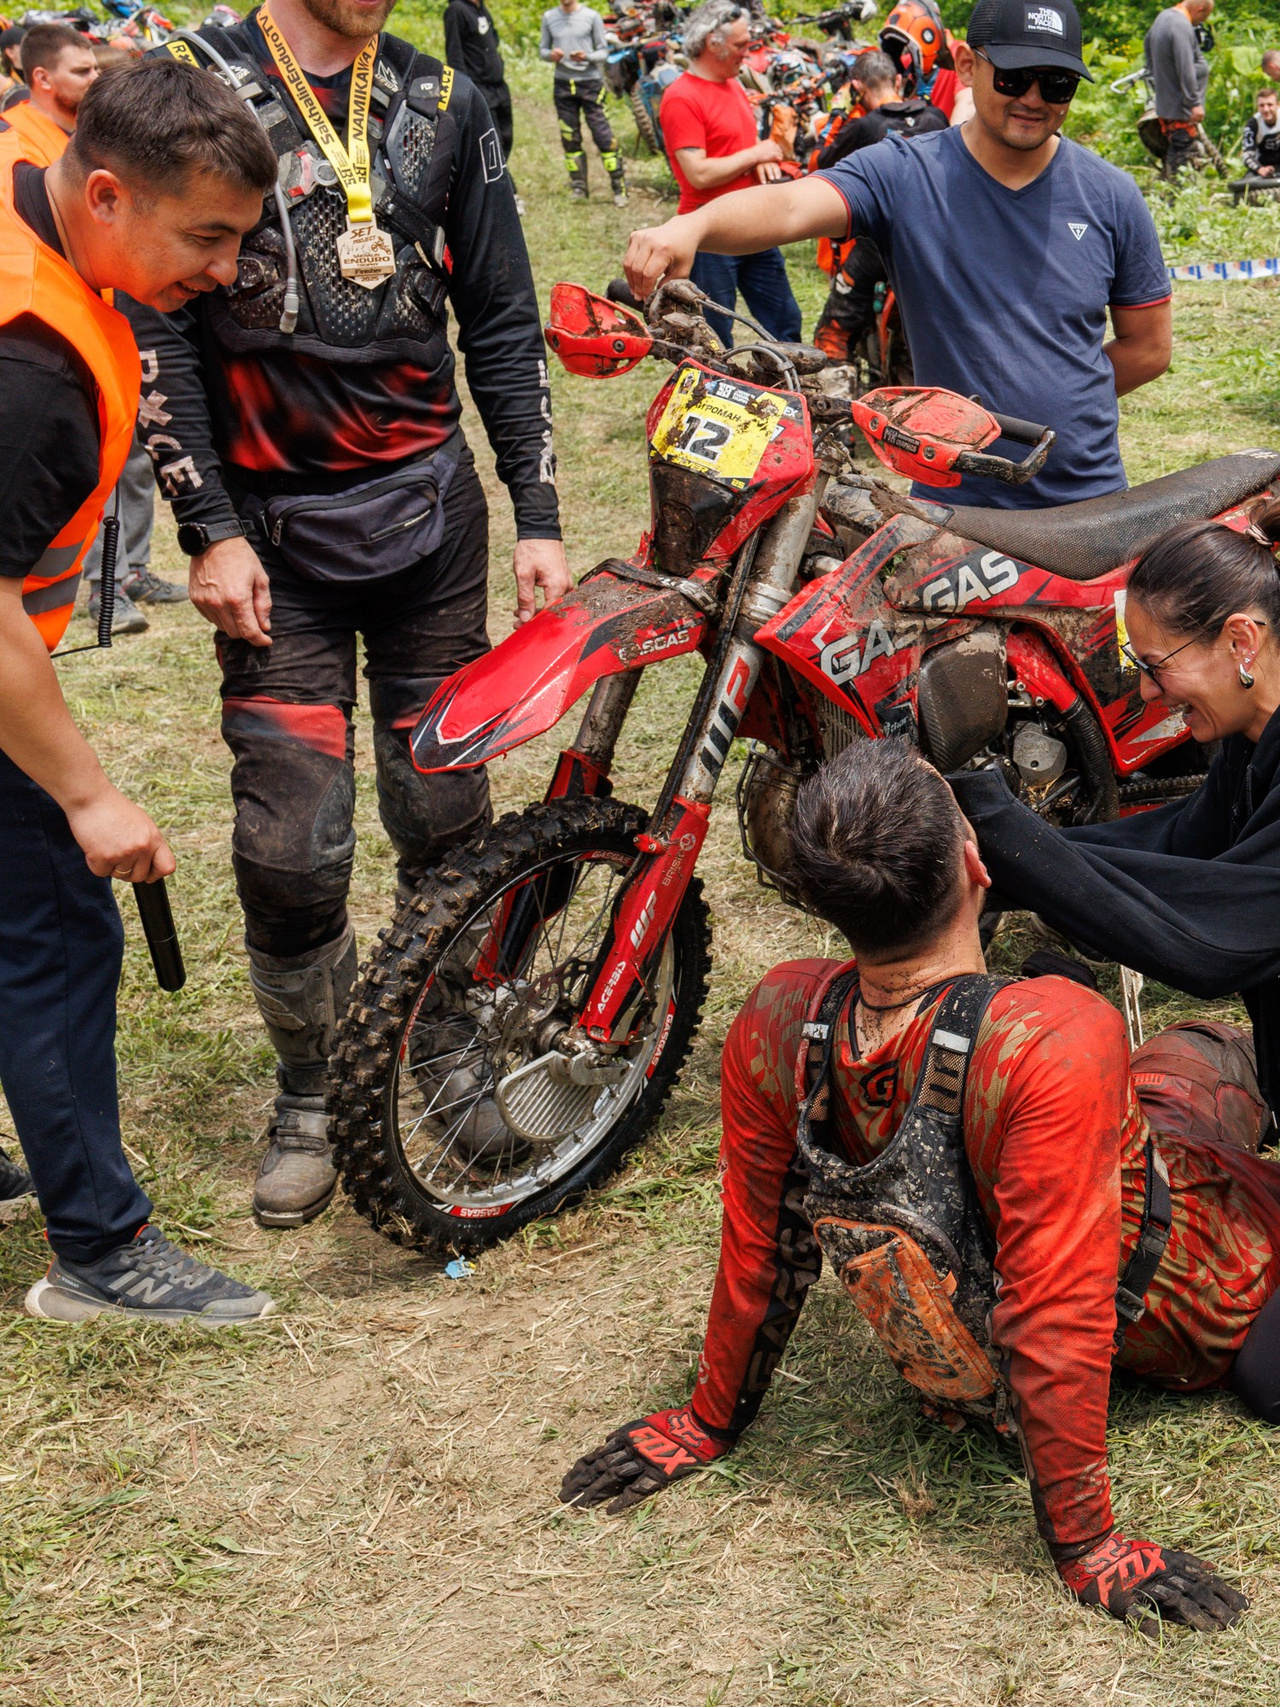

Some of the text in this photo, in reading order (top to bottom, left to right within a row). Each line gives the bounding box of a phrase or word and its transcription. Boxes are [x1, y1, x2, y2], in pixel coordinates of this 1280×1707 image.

[353, 50, 372, 142] NAMIKAWA
[350, 225, 374, 240] SET
[344, 256, 390, 265] ENDURO
[679, 414, 732, 463] 12
[597, 960, 627, 1014] ACERBIS
[650, 1013, 674, 1067] GASGAS
[460, 1206, 501, 1218] GASGAS
[628, 1426, 698, 1476] FOX
[1096, 1547, 1167, 1609] FOX
